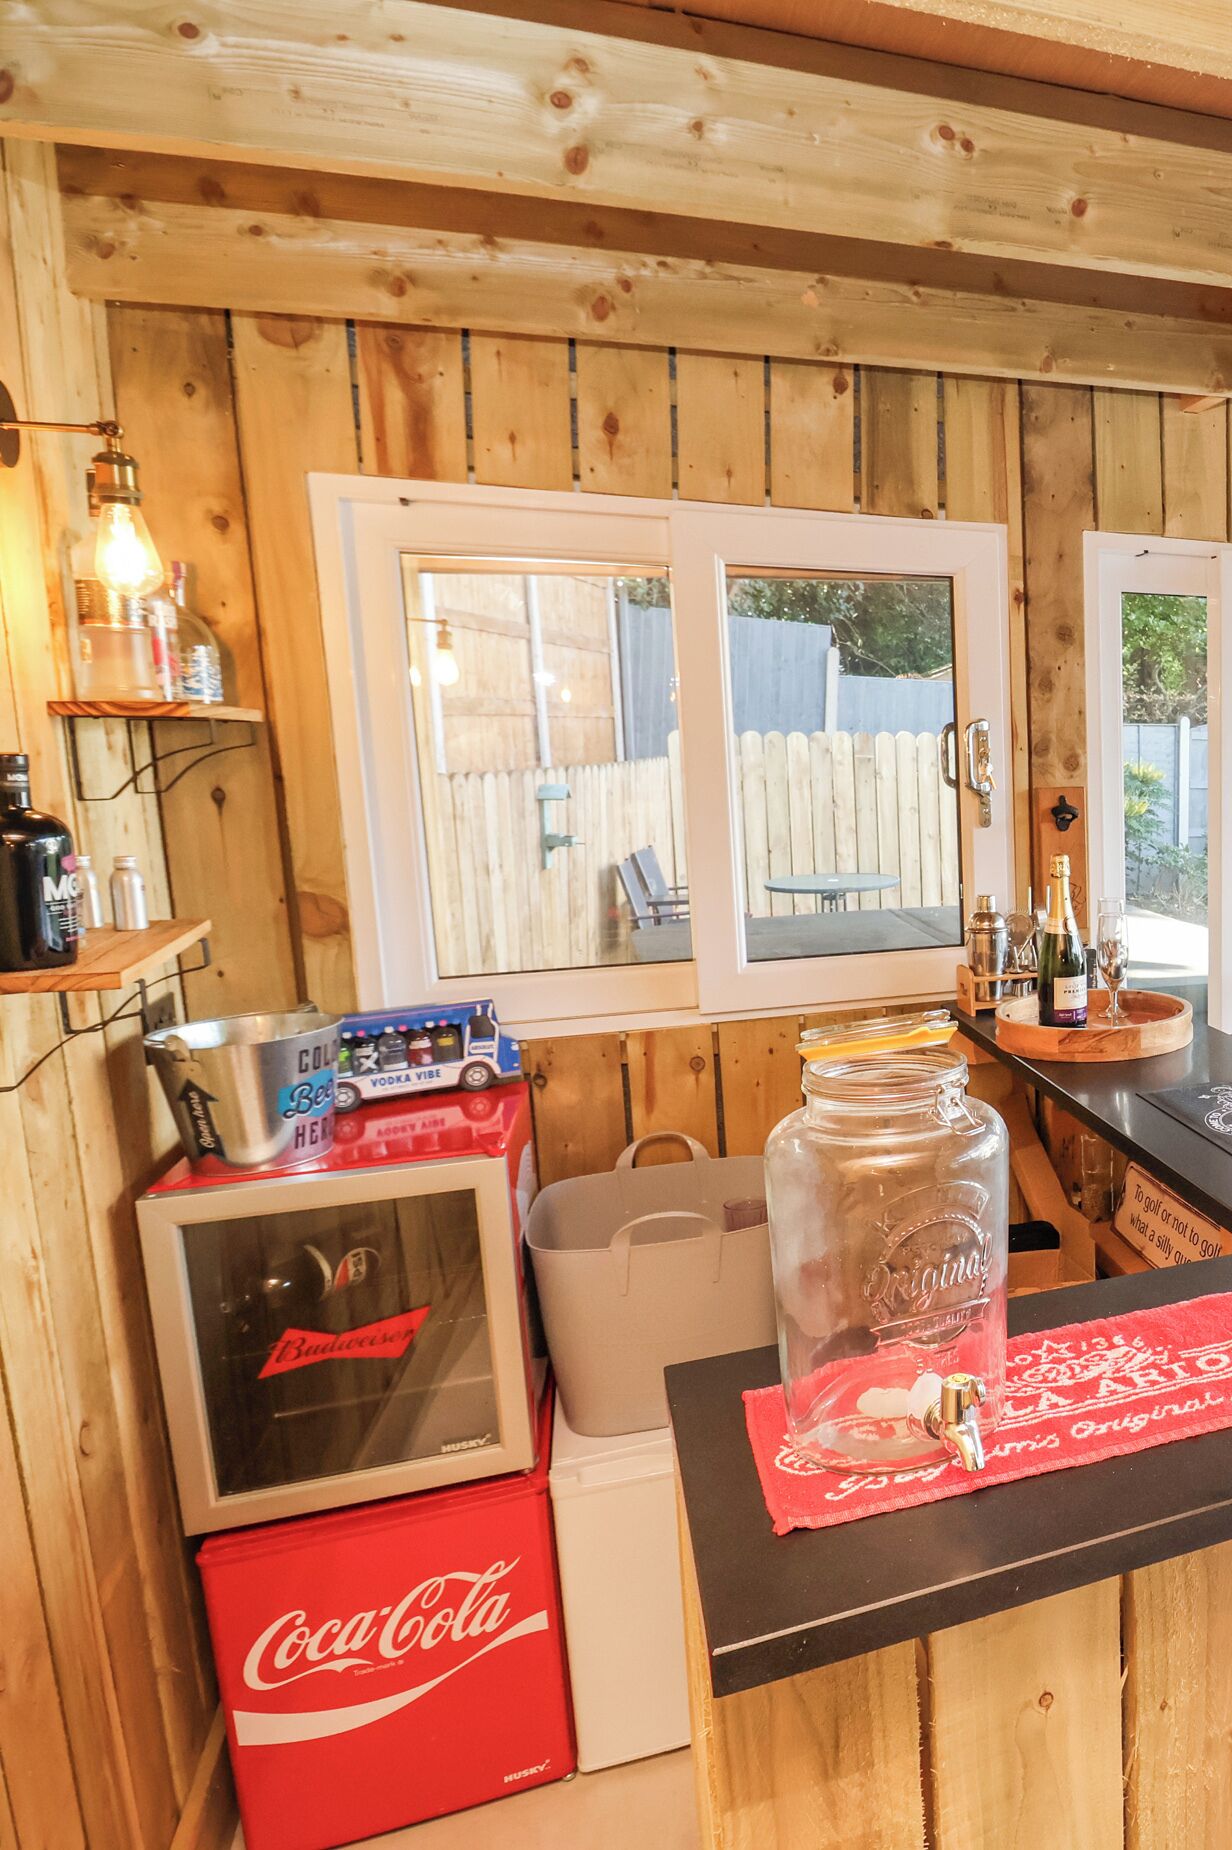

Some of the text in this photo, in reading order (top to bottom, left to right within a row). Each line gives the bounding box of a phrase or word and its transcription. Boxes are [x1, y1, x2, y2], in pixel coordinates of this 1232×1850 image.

[283, 1078, 335, 1120] Bee
[370, 1074, 412, 1088] VODKA
[415, 1069, 441, 1080] VIBE
[188, 1091, 215, 1149] Open here
[1130, 1213, 1149, 1238] what
[1148, 1230, 1156, 1243] a
[1155, 1234, 1174, 1261] silly
[1134, 1184, 1223, 1258] To golf or not to golf
[269, 1329, 416, 1363] Budweiser
[1081, 1334, 1145, 1351] 1366
[1070, 1392, 1225, 1440] Original
[440, 1433, 492, 1454] HUSKY
[243, 1555, 521, 1691] Coca-Cola
[503, 1759, 551, 1784] HUSKY
